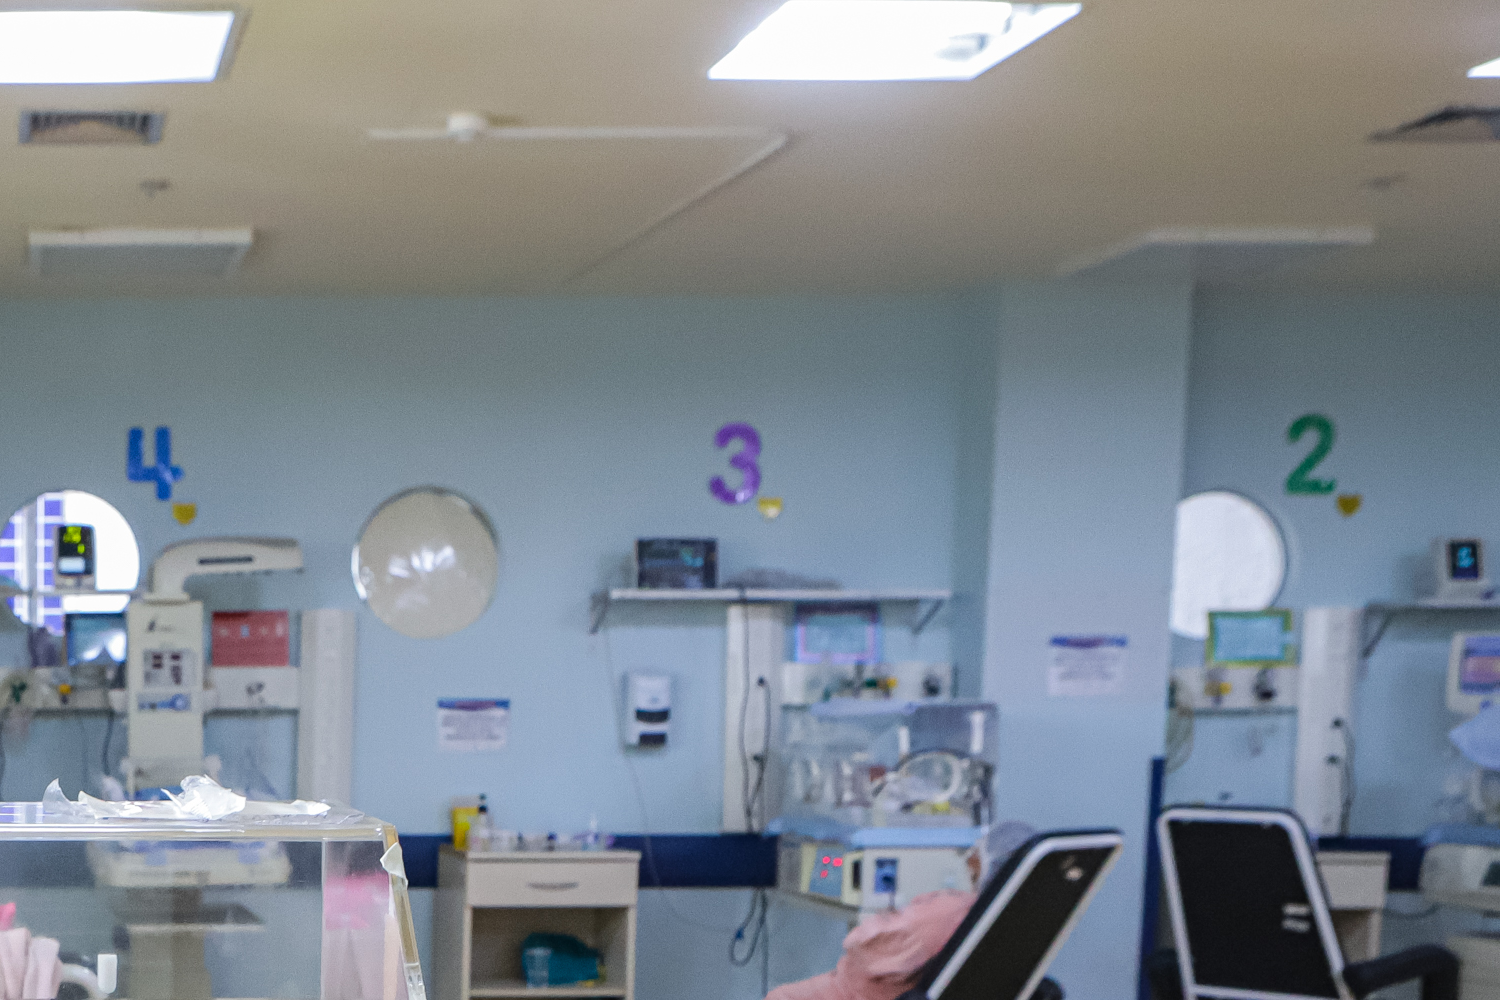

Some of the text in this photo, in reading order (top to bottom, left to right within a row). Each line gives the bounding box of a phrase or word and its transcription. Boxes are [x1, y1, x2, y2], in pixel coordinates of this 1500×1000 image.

[127, 426, 184, 501] 4
[708, 422, 762, 505] 3
[1285, 413, 1336, 495] 2
